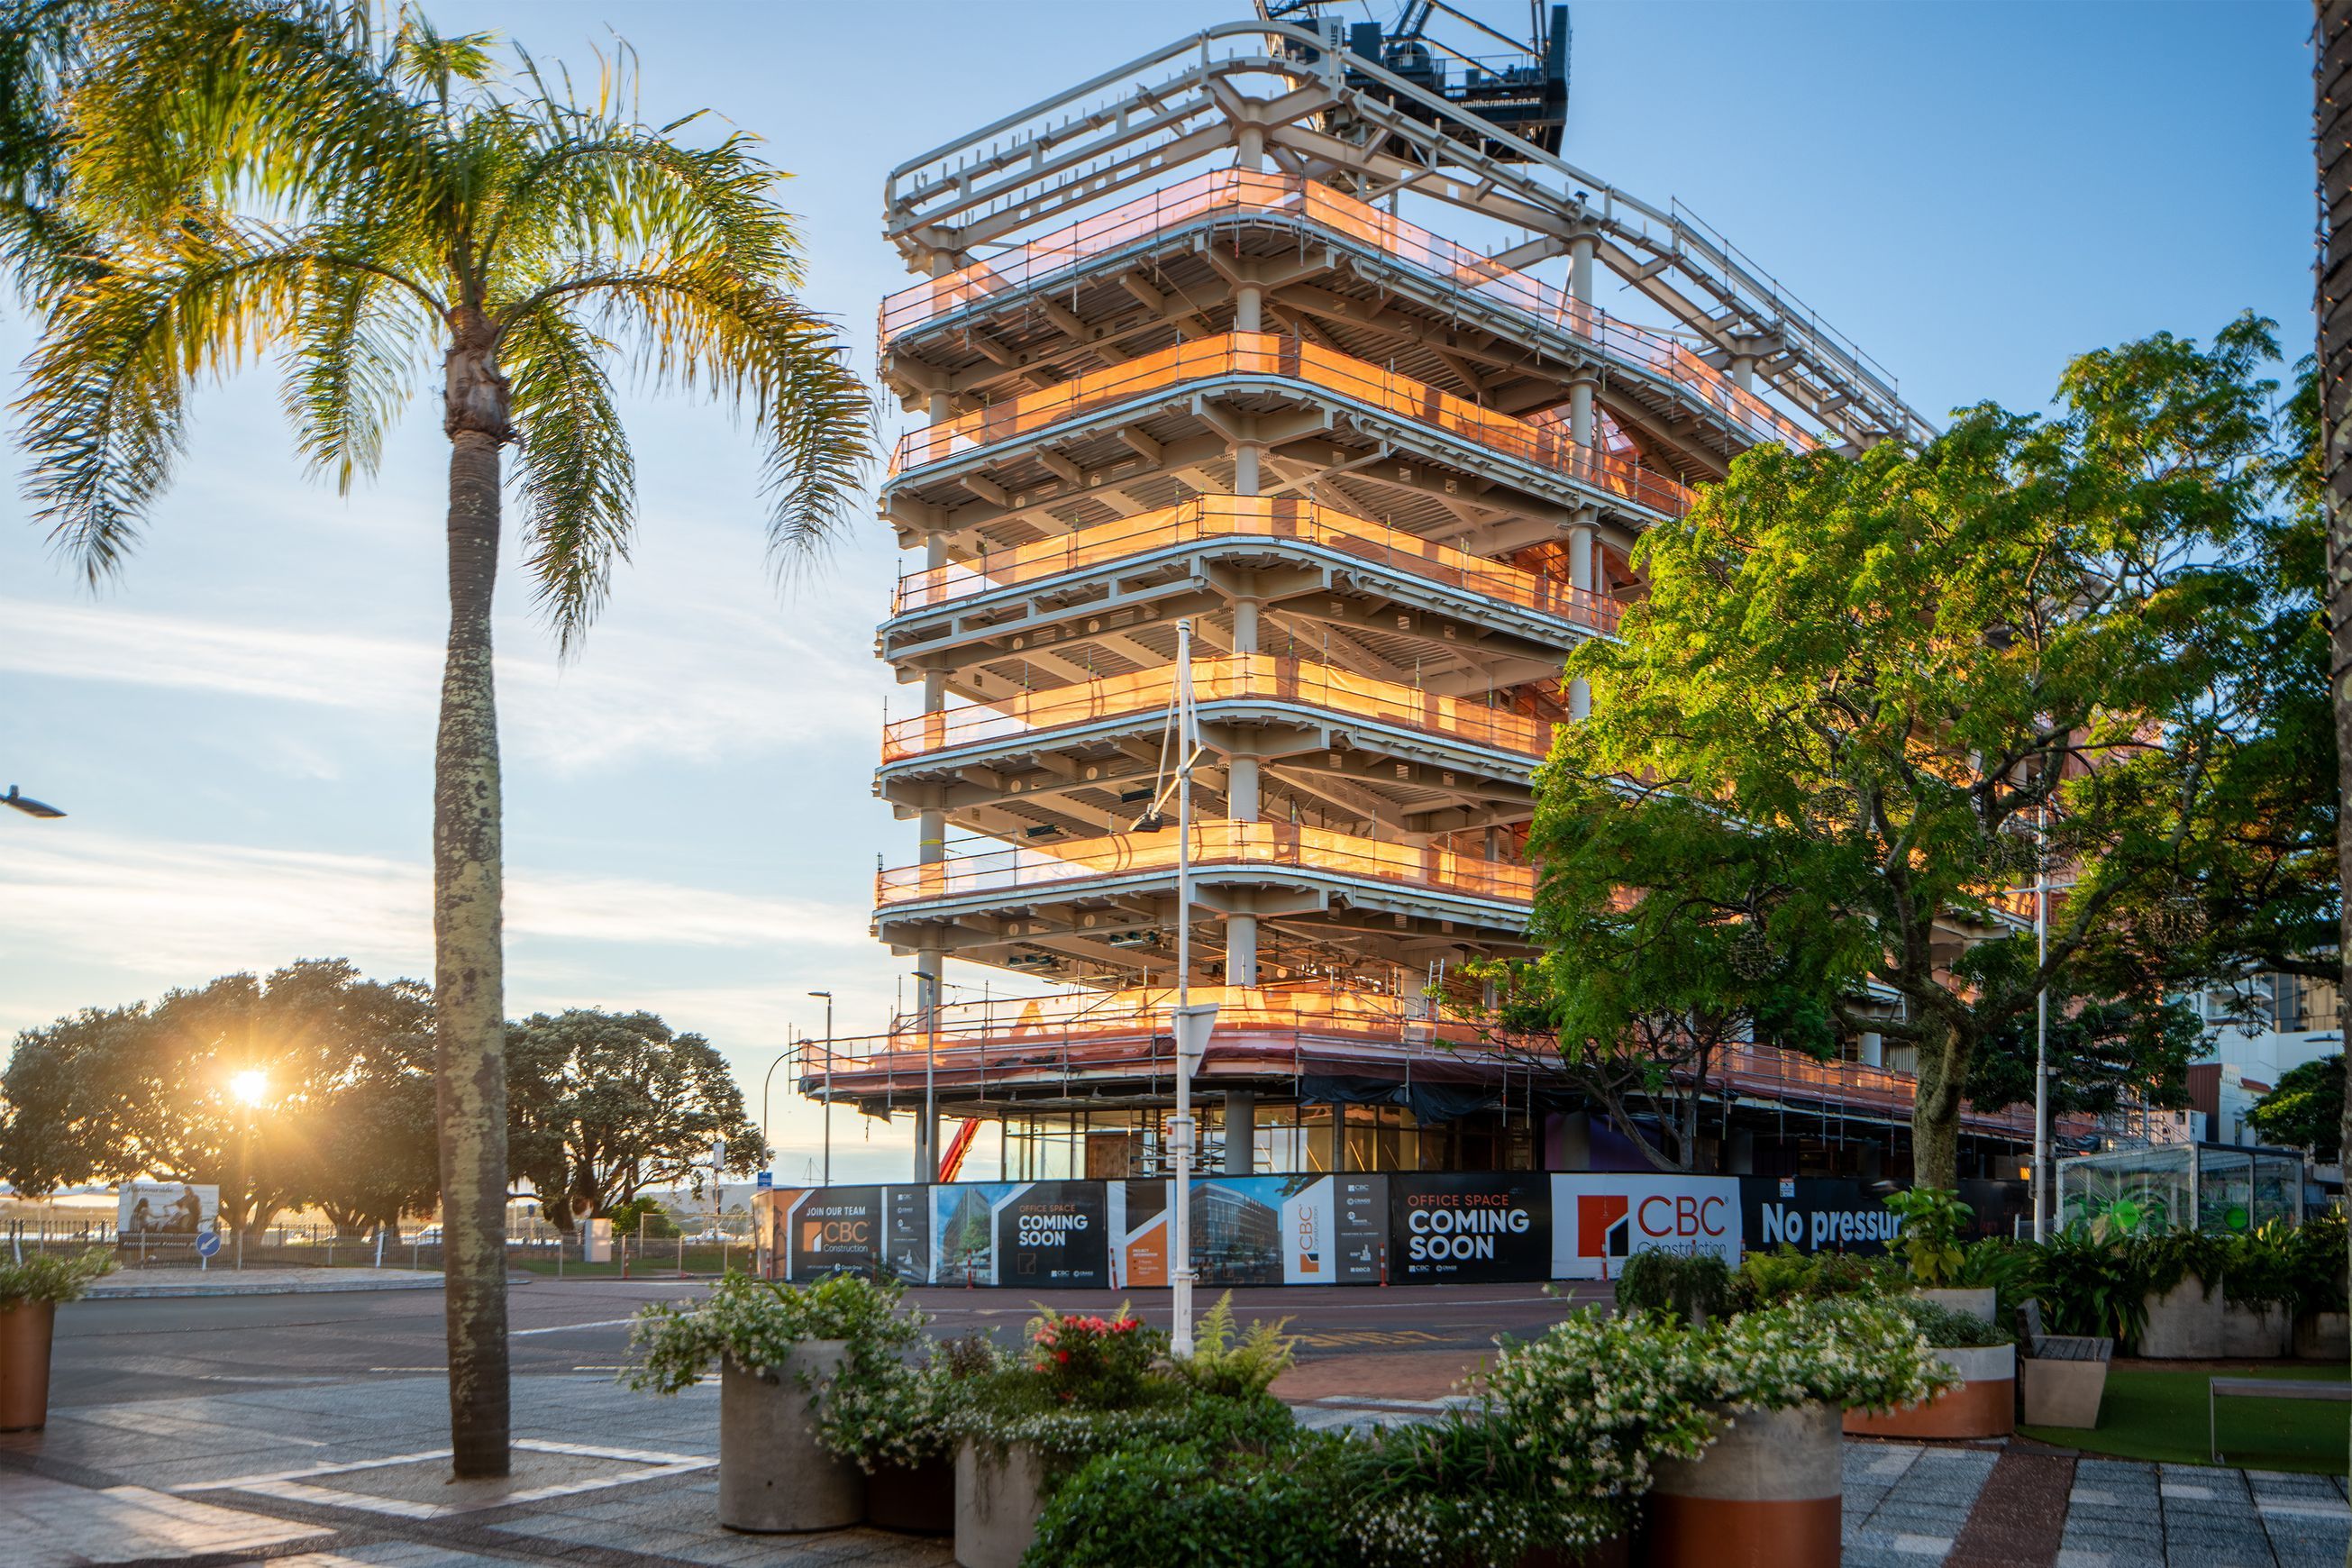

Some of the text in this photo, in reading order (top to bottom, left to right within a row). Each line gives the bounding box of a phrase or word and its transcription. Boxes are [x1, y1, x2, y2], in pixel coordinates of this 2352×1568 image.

[1408, 1194, 1509, 1207] OFFICE SPACE
[807, 1206, 866, 1217] JOIN OUR TEAM
[1019, 1204, 1076, 1213] OFFICE SPACE
[1018, 1214, 1089, 1230] COMING
[1408, 1208, 1530, 1234] COMING
[1762, 1203, 1803, 1244] No
[1018, 1231, 1066, 1246] SOON
[824, 1244, 869, 1253] Construction
[1408, 1235, 1495, 1260] SOON
